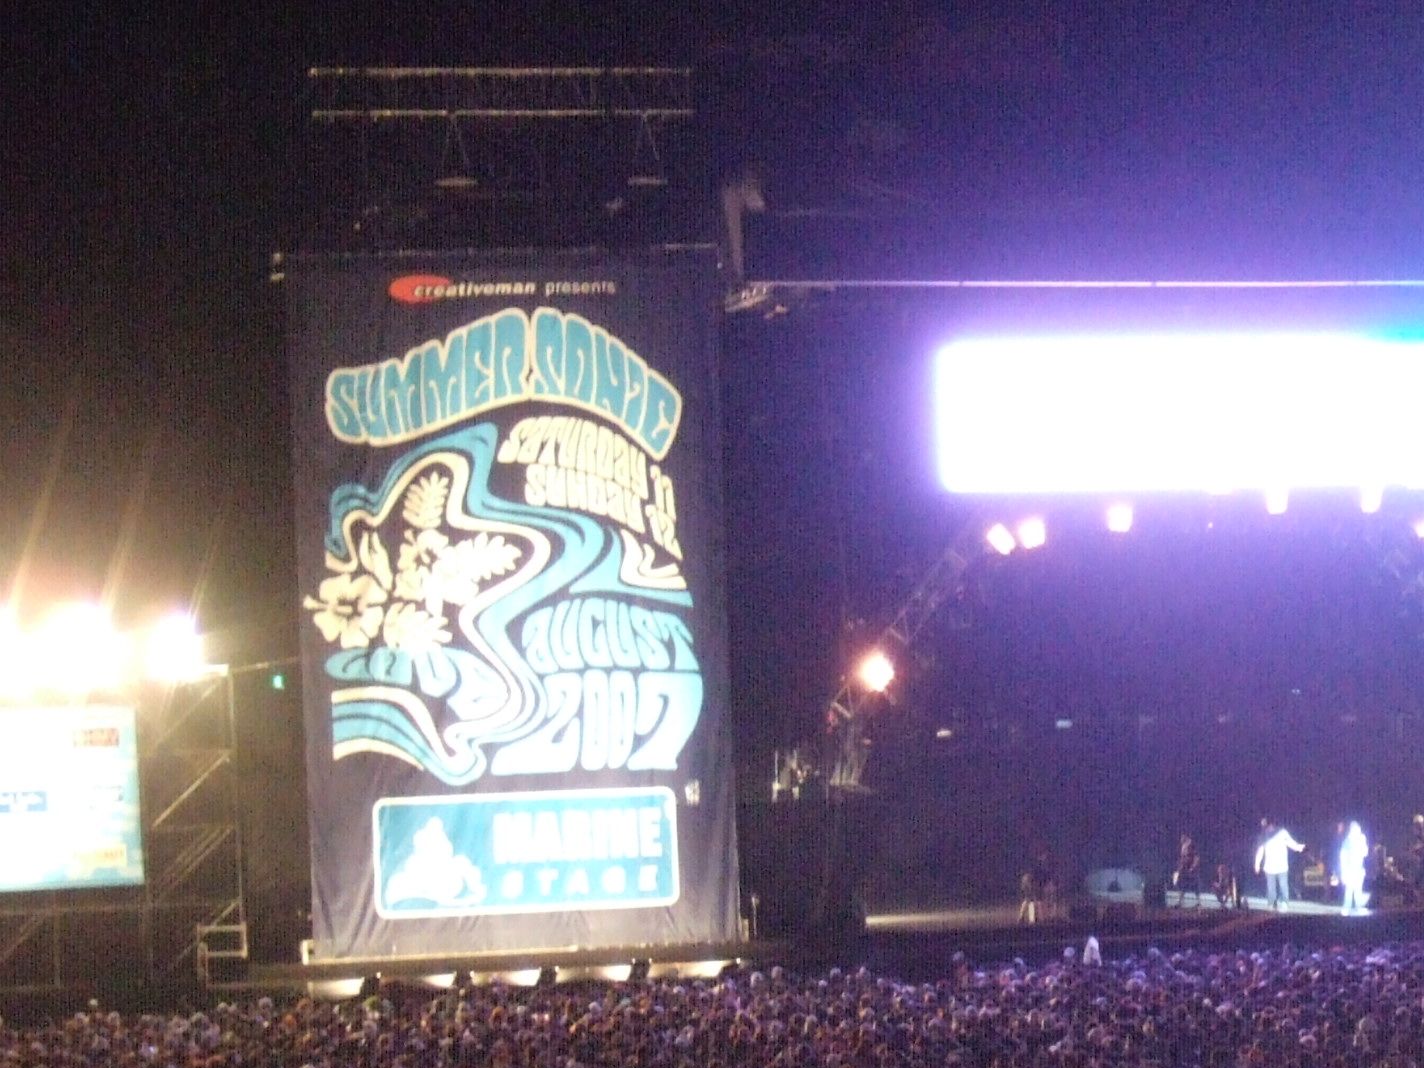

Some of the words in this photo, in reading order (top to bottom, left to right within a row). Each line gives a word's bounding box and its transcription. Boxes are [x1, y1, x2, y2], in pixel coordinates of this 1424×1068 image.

[414, 280, 536, 298] creativeman
[544, 279, 617, 297] presents
[326, 308, 531, 446] SUMMER
[531, 307, 682, 461] SONIC
[491, 669, 703, 776] 2007
[492, 806, 663, 864] MARINE
[501, 864, 660, 899] STAGE
